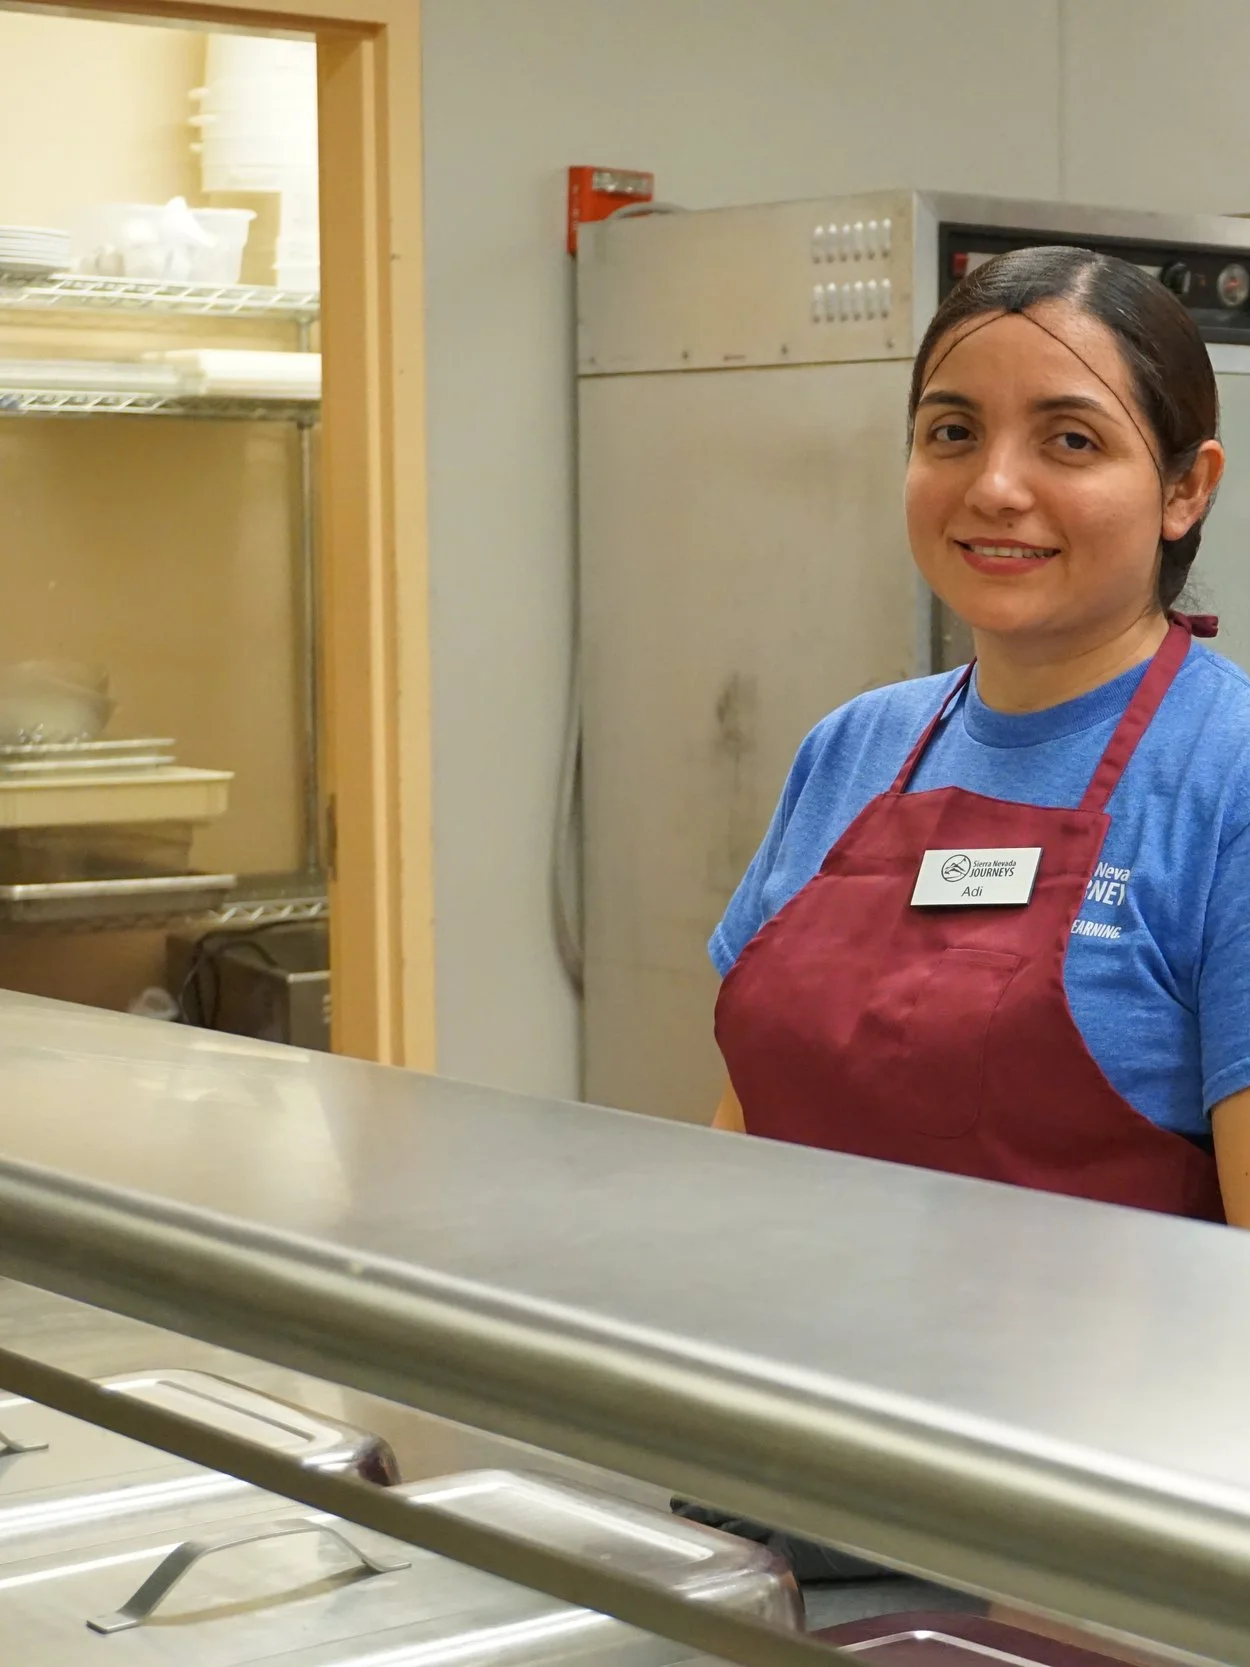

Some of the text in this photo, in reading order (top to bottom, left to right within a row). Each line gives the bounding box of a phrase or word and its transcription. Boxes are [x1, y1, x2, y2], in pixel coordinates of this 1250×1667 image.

[973, 859, 1017, 868] Sierra Nevada
[969, 867, 1015, 878] JOURNEYS
[961, 885, 984, 897] Adi
